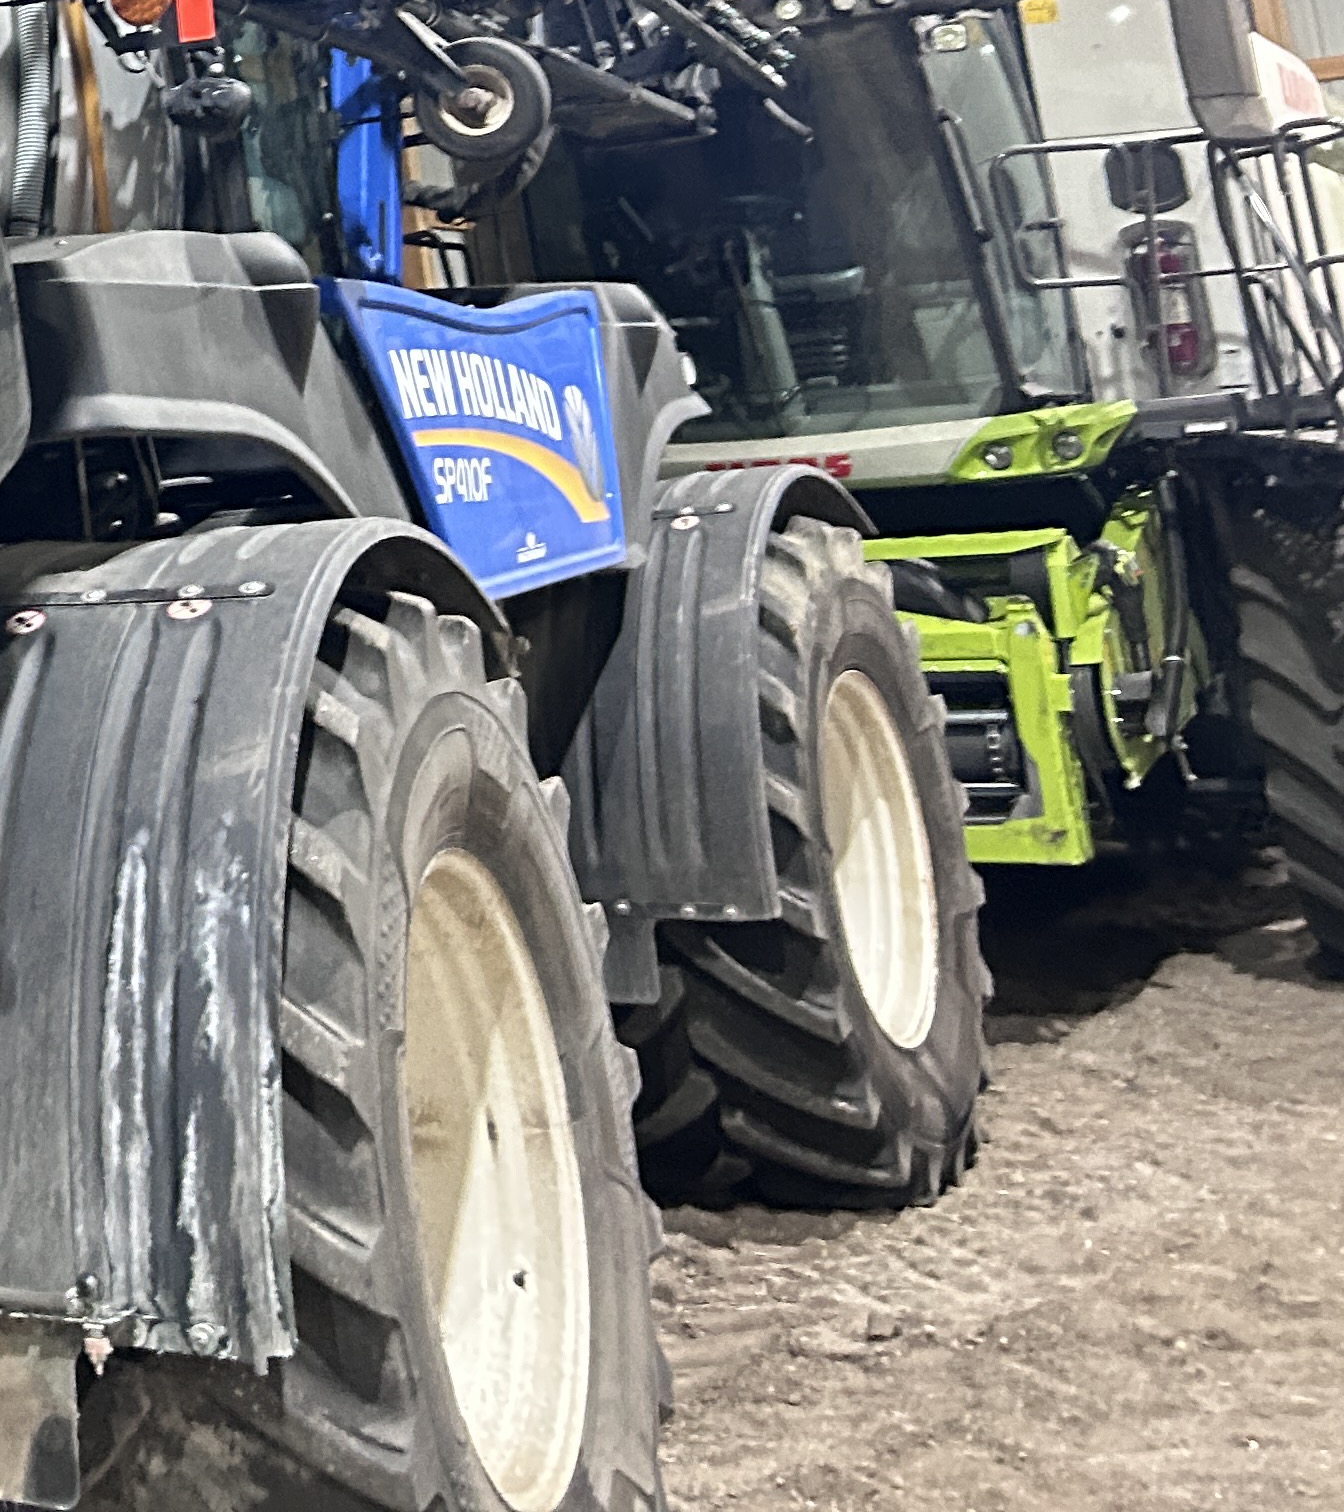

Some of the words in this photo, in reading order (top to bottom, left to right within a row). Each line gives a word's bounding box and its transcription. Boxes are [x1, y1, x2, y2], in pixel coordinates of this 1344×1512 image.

[388, 348, 459, 420] NEW
[450, 349, 563, 441] HOLLAND
[433, 456, 492, 505] SP410F
